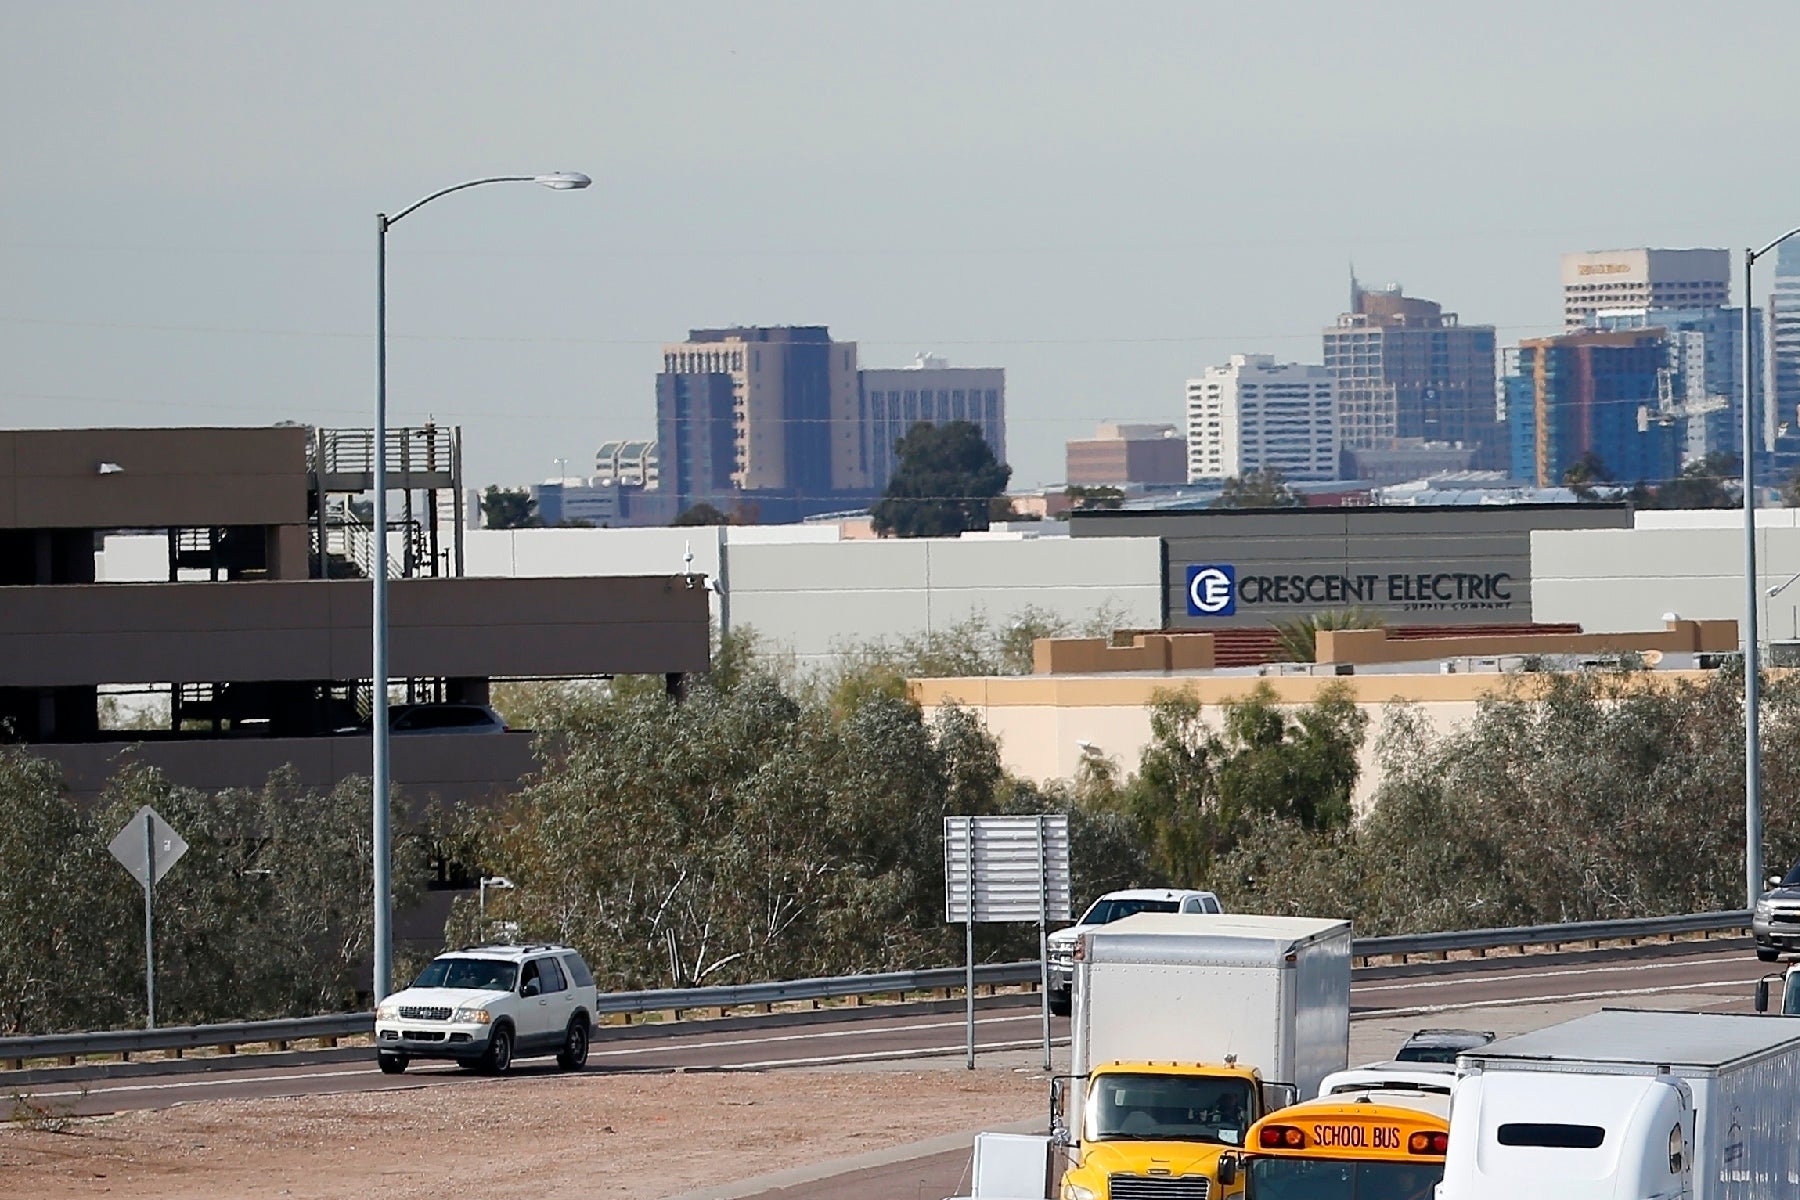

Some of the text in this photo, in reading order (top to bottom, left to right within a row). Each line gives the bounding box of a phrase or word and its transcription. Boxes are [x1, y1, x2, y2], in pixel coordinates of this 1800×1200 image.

[1238, 574, 1379, 604] CRESCENT
[1388, 572, 1512, 601] ELECTRIC
[1403, 601, 1512, 612] SUPPLY COMPANY
[1313, 1124, 1401, 1149] SCHOOL BUS
